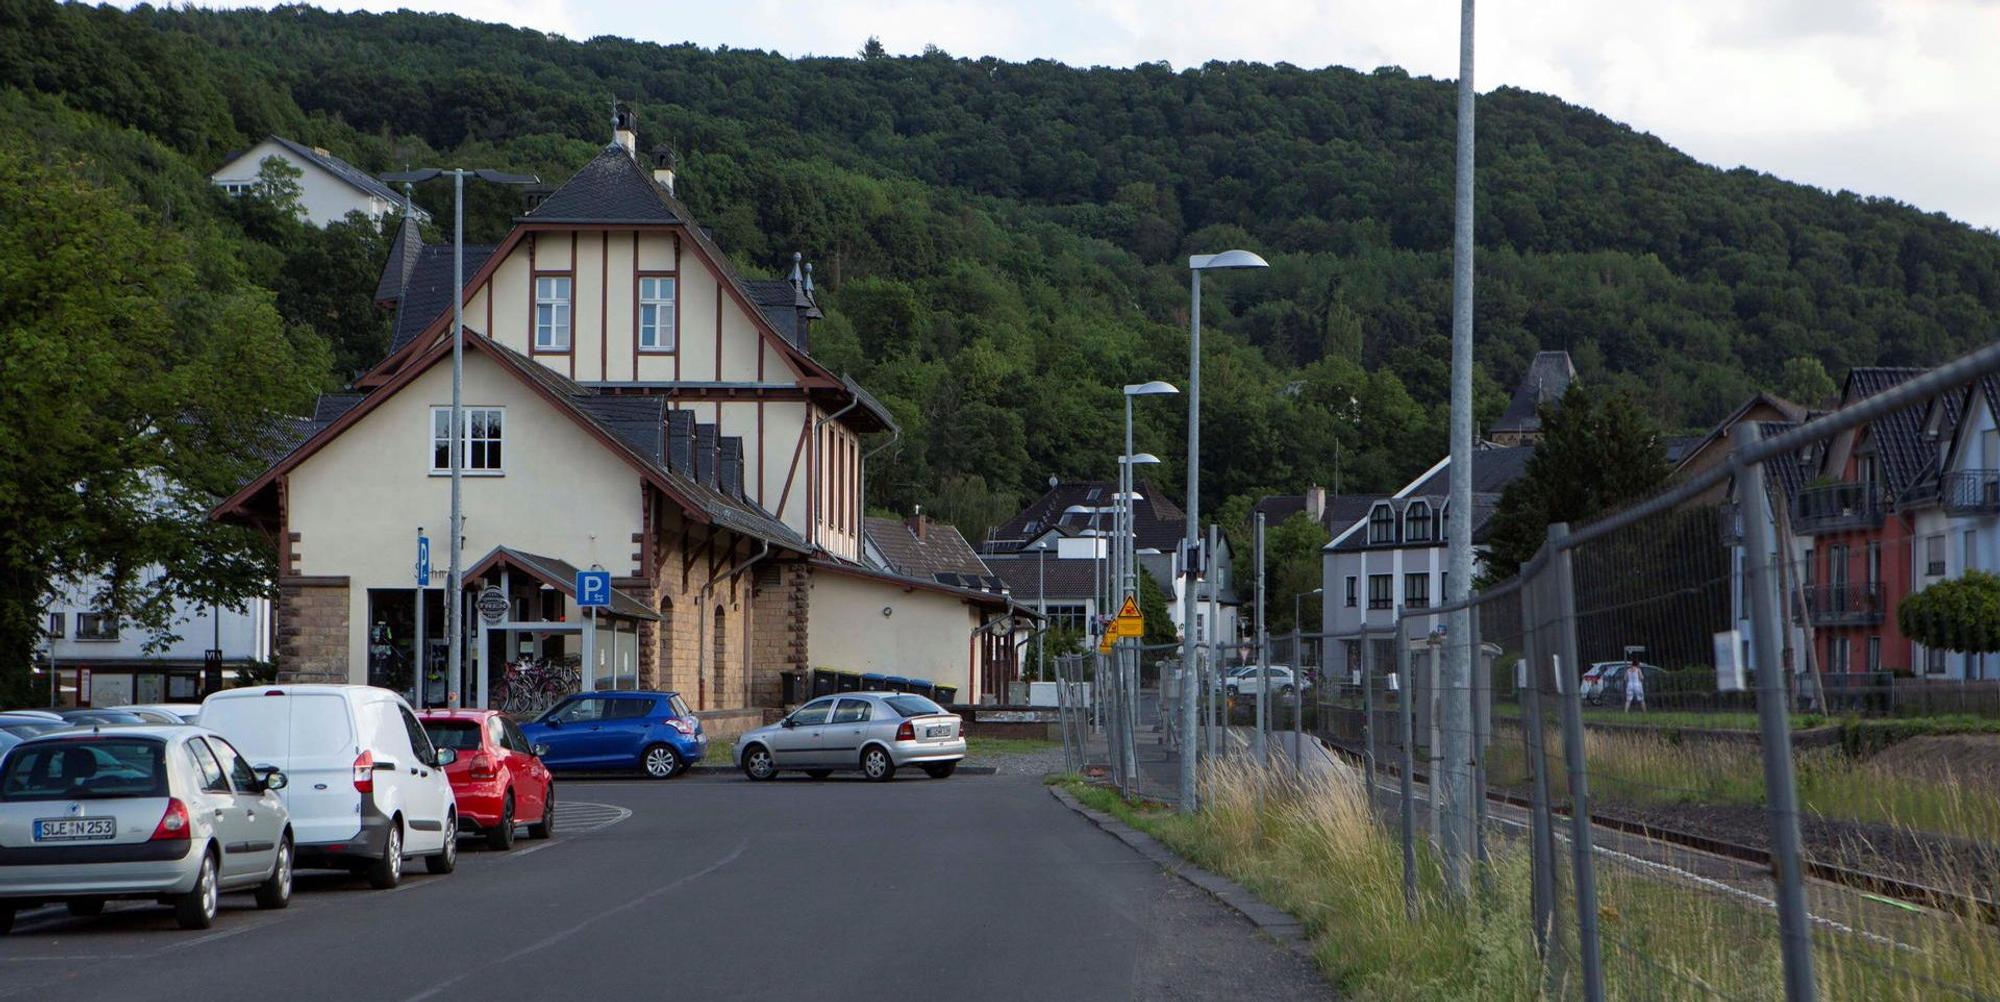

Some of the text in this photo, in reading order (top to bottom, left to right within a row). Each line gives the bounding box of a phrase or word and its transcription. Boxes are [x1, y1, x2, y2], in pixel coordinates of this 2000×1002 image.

[420, 543, 428, 580] P
[585, 576, 602, 601] P
[43, 821, 112, 836] SLE N 253
